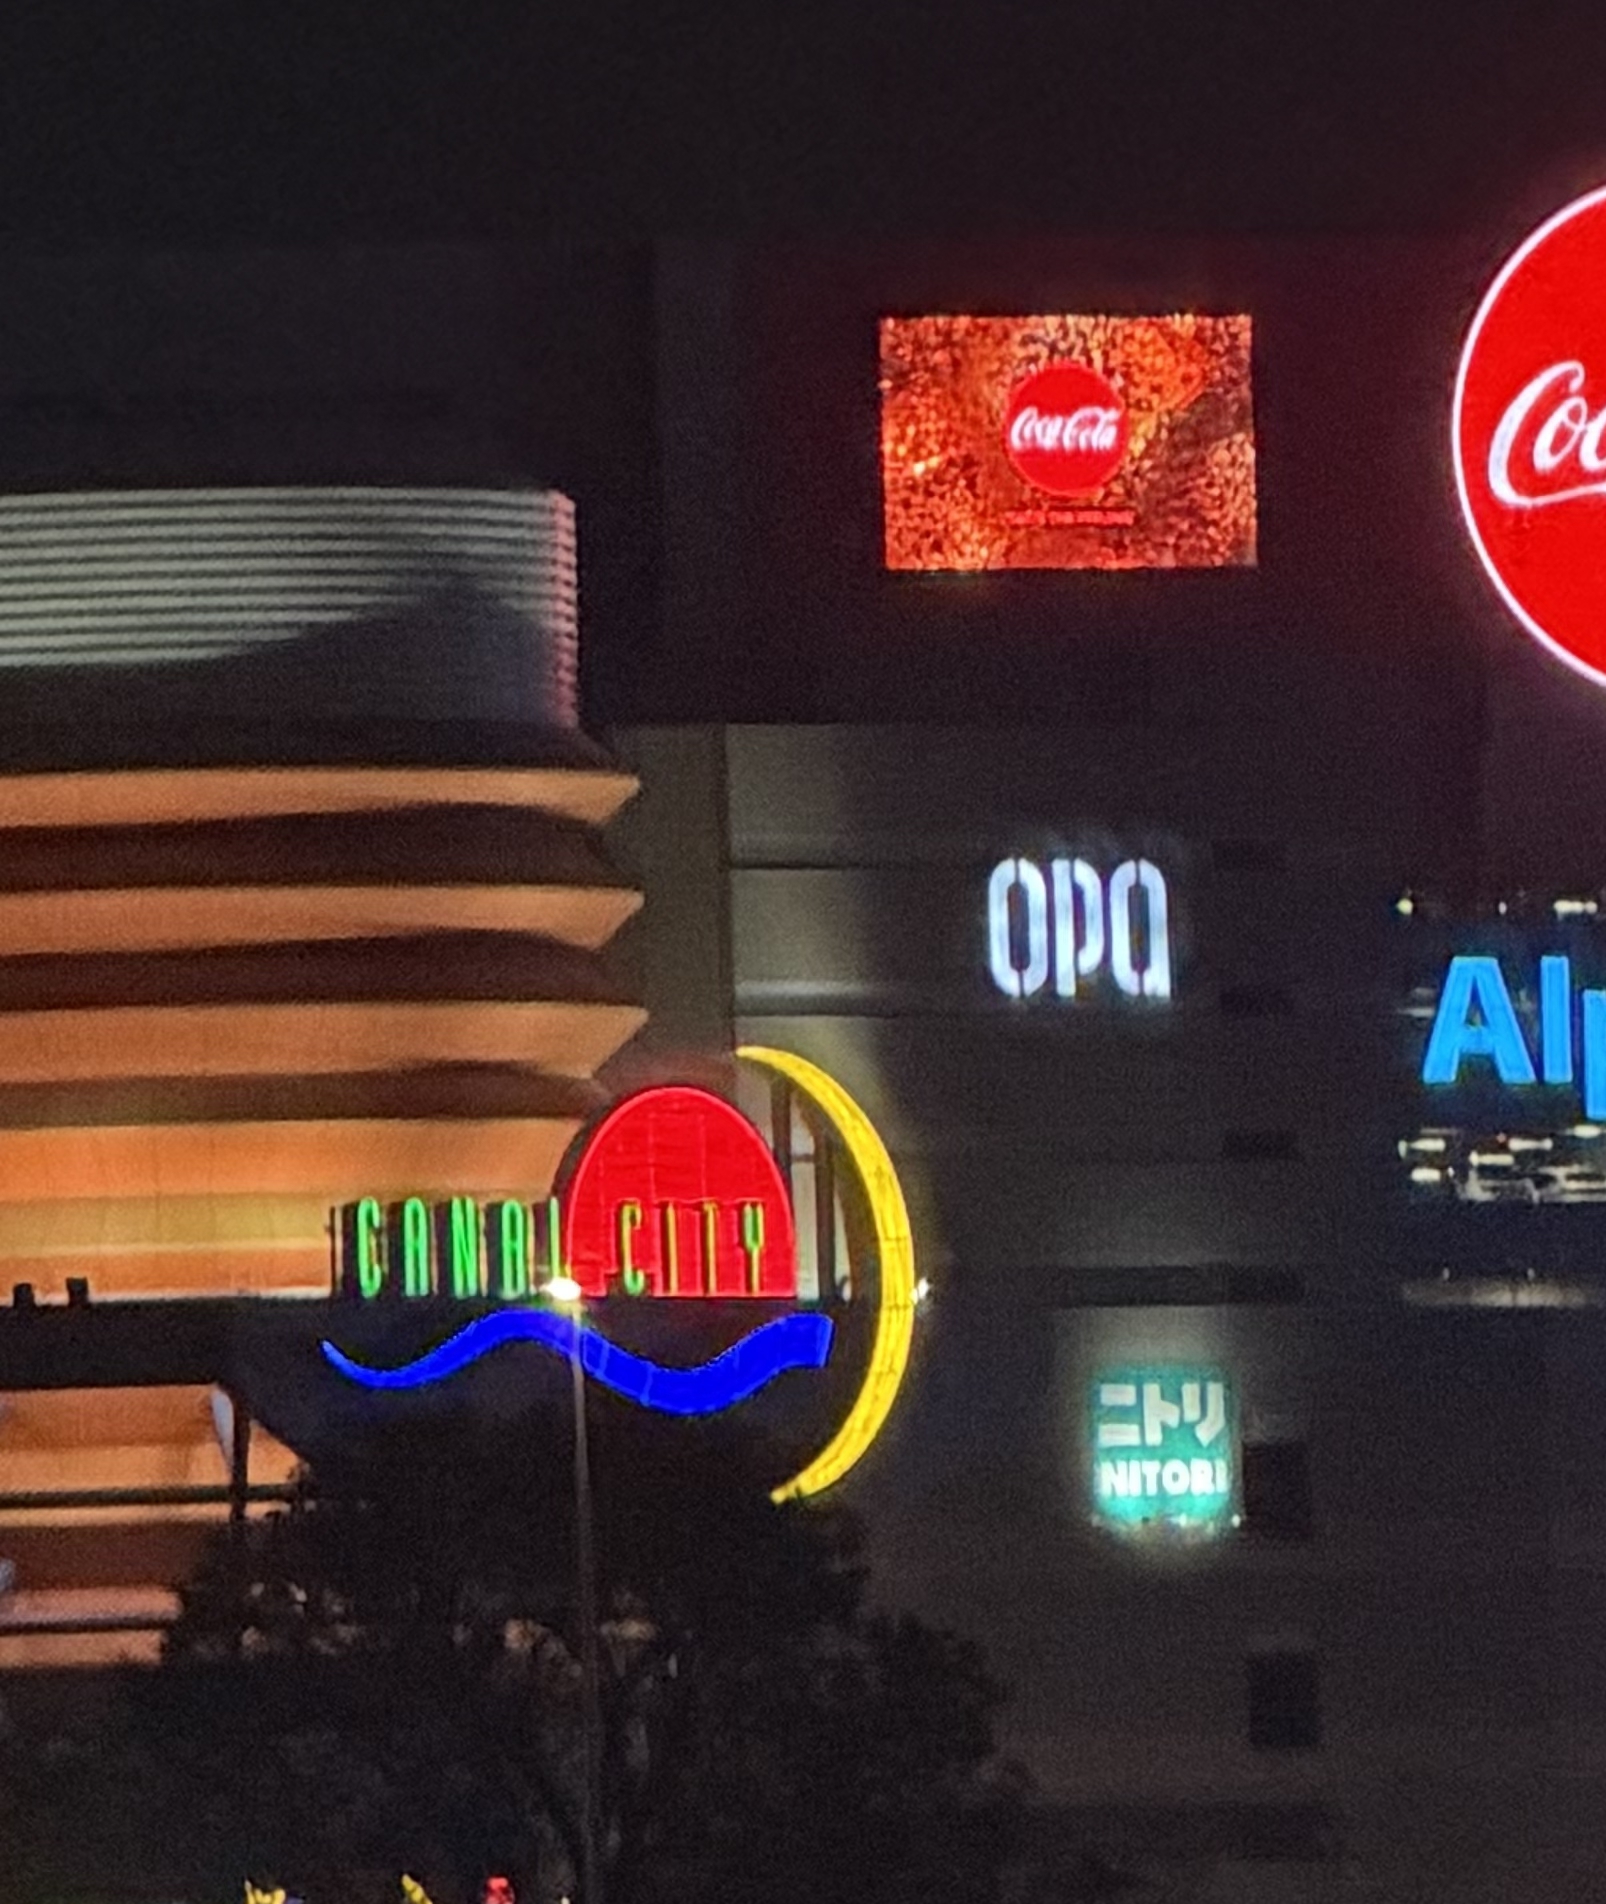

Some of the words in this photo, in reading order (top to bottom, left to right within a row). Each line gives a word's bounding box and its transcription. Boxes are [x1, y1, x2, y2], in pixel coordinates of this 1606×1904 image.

[620, 1197, 767, 1297] CITY
[1098, 1381, 1226, 1448] ニトリ
[1100, 1457, 1228, 1497] NITORI
